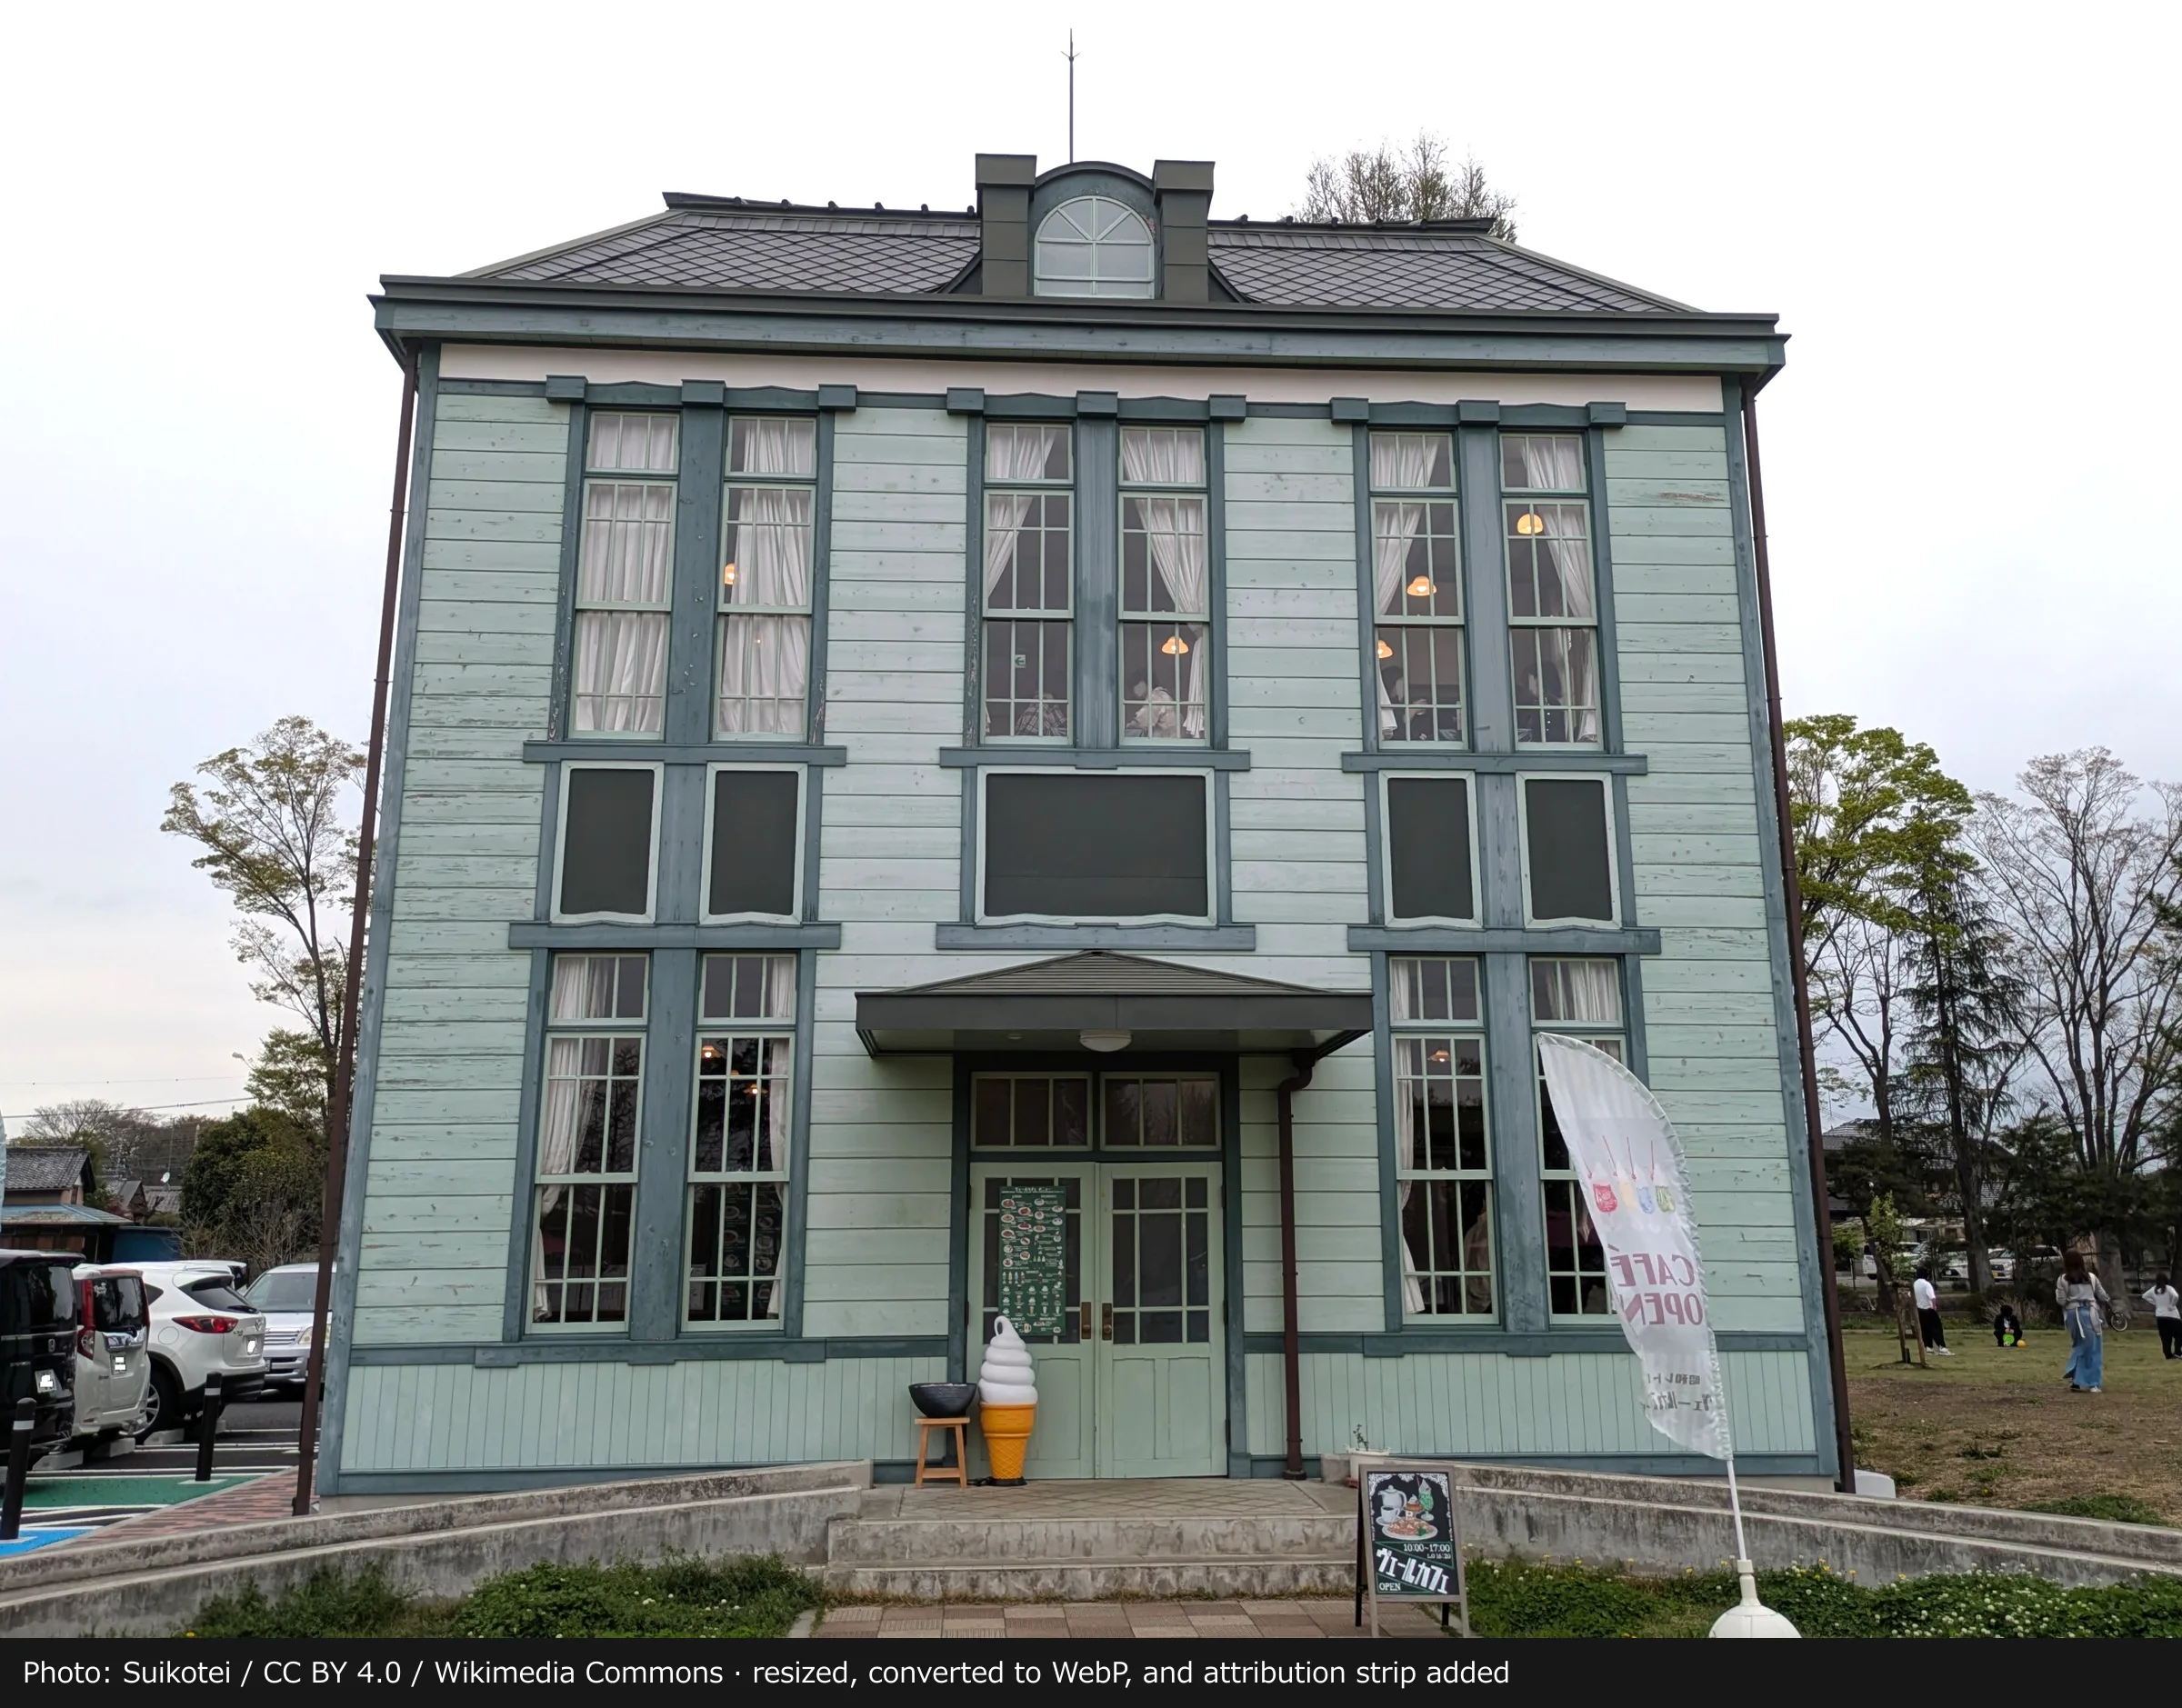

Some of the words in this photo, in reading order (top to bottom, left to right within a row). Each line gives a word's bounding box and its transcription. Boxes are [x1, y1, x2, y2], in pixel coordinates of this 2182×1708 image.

[1376, 1547, 1449, 1594] ヴェールカフェ
[1379, 1583, 1401, 1591] OPEN
